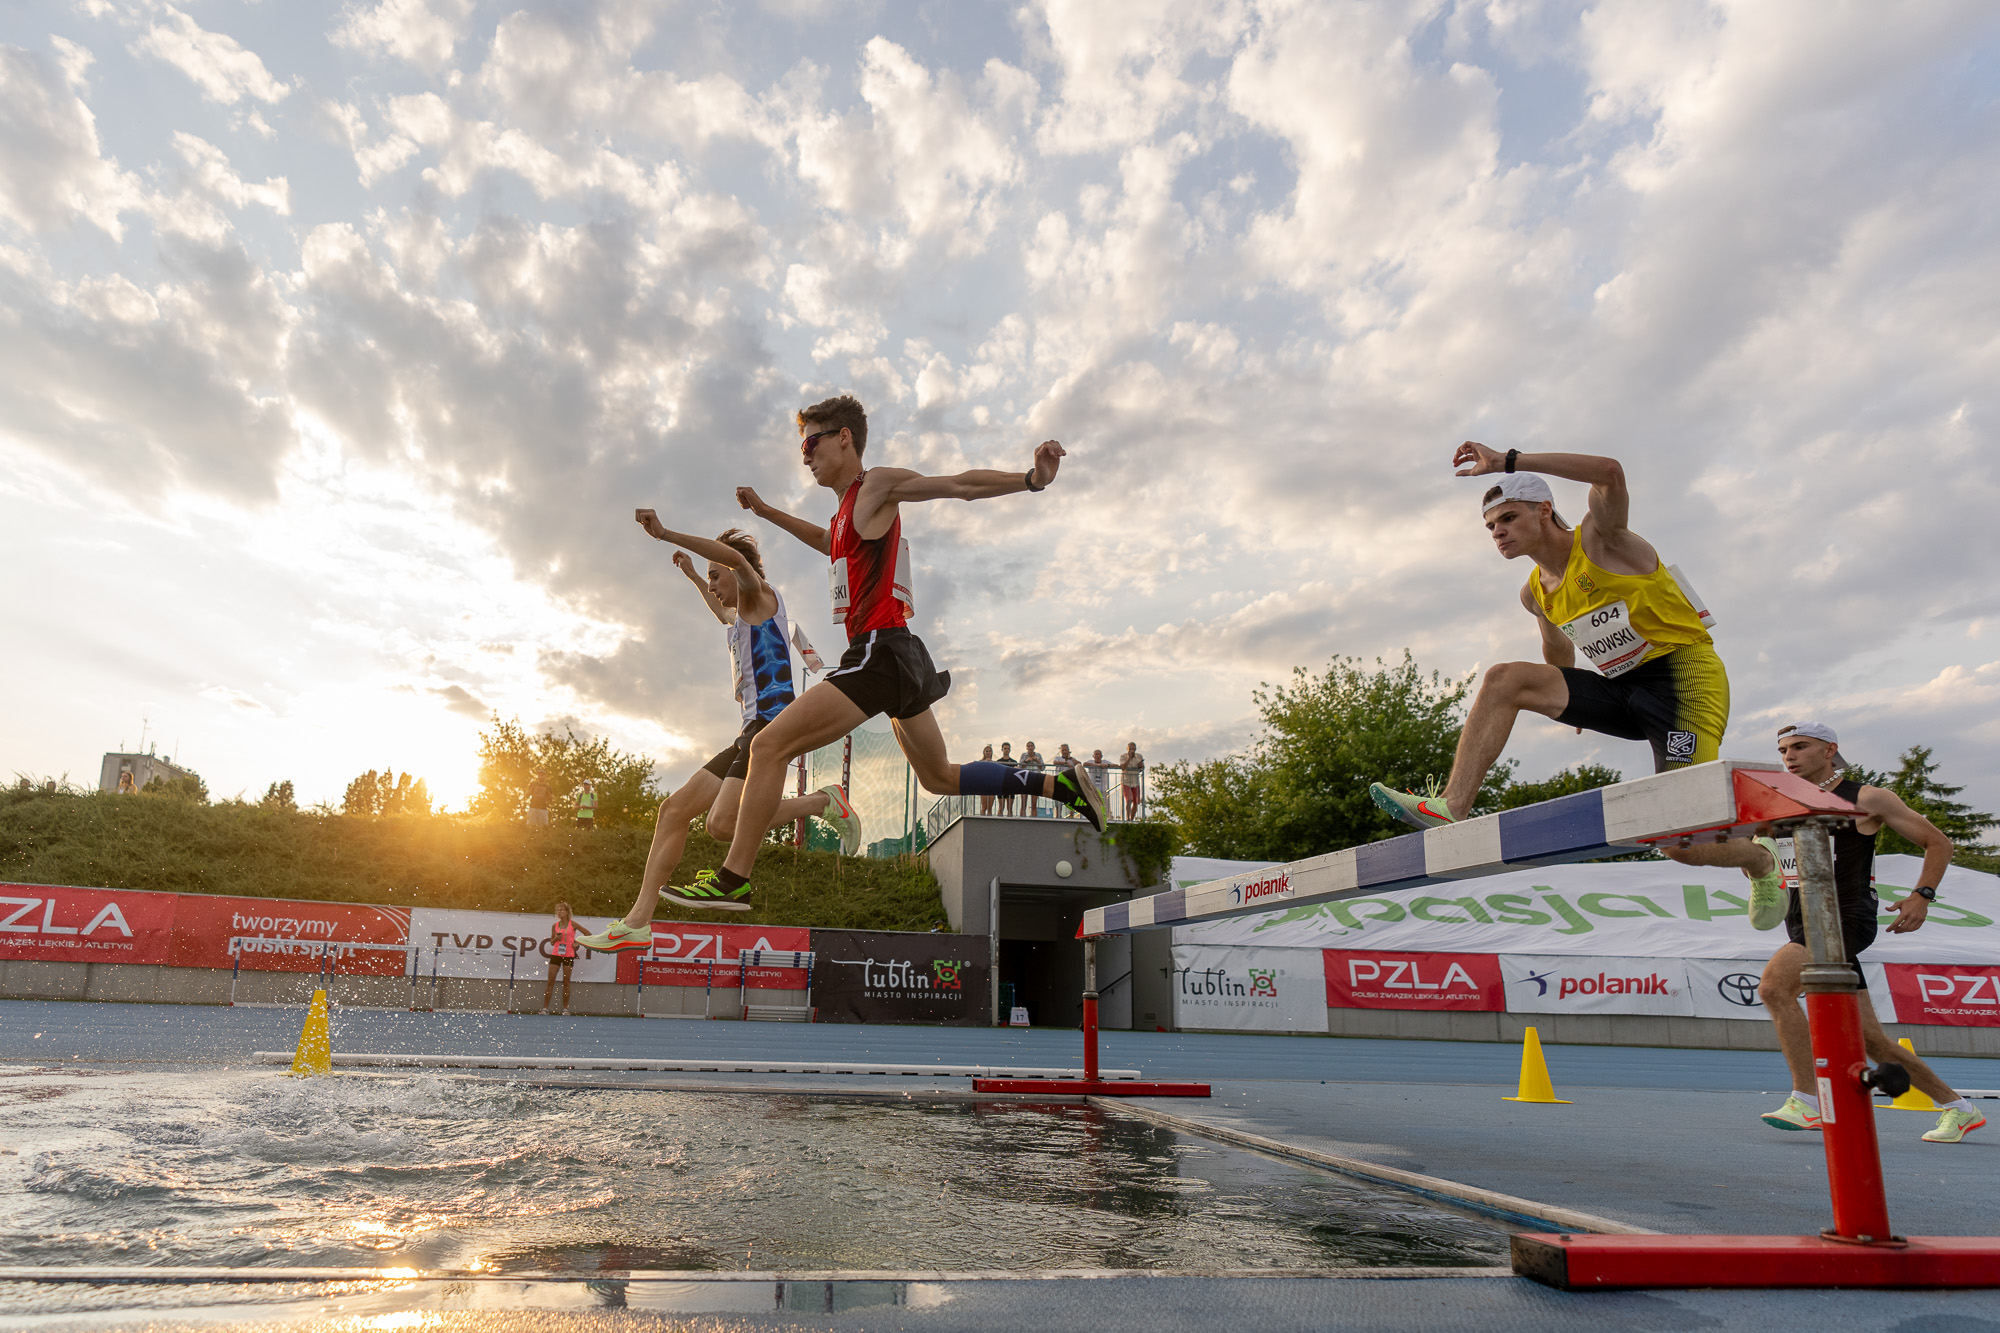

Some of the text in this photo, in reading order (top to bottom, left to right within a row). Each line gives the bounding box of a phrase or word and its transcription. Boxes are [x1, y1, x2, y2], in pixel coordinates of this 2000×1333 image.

[1591, 607, 1620, 628] 604
[1580, 627, 1636, 659] ONOWSKI
[1618, 660, 1635, 673] 2023
[232, 912, 339, 938] tworzymy
[38, 939, 82, 948] LEKKIEJ
[85, 941, 133, 950] ATLETYKI
[502, 935, 592, 960] SPO
[646, 967, 675, 975] POLSKI
[1348, 959, 1478, 990] PZLA
[1559, 972, 1669, 1000] polanik
[864, 991, 962, 1001] MIASTO INSPIRACJI
[1224, 1000, 1278, 1009] INSPIRACJI
[1924, 1007, 1955, 1015] POLSKI
